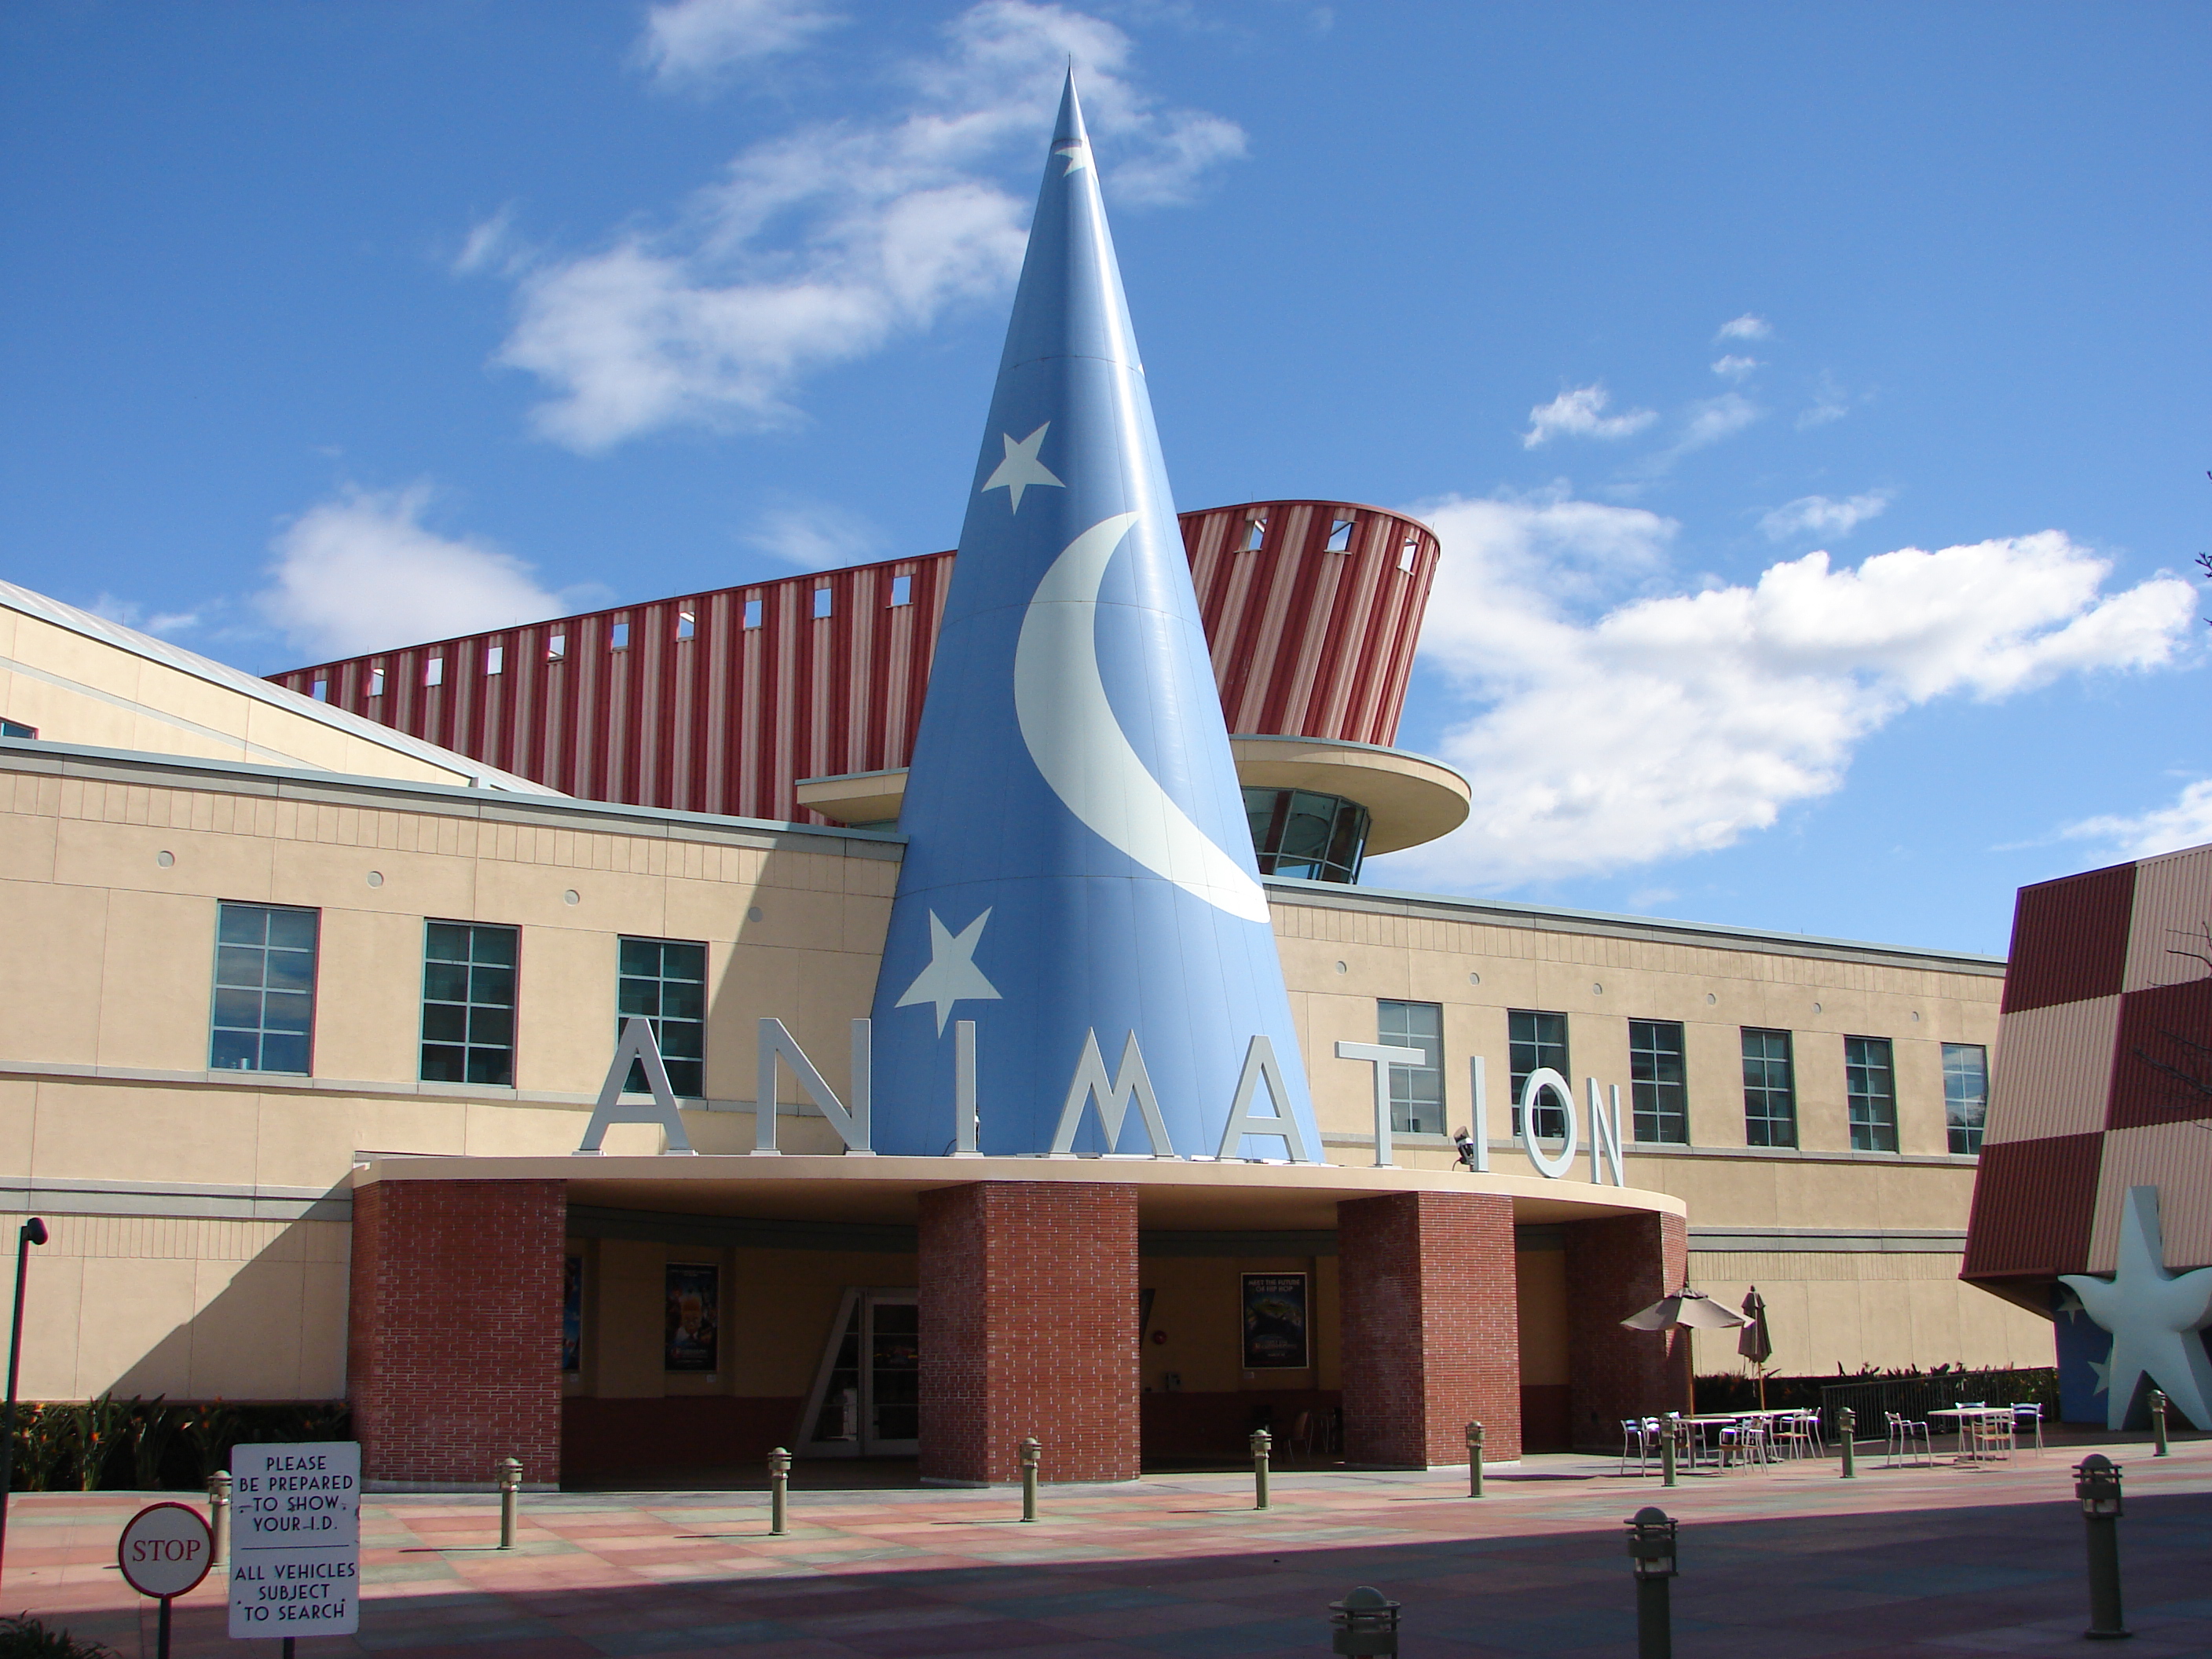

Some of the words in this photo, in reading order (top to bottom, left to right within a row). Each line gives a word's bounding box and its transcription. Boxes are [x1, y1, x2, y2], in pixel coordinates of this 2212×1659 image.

[577, 1016, 1624, 1187] ANIMATION
[266, 1456, 327, 1471] PLEASE
[240, 1477, 259, 1492] BE
[269, 1475, 353, 1492] PREPARED
[253, 1497, 278, 1512] TO
[287, 1495, 339, 1511] SHOW
[254, 1516, 301, 1532] YOUR
[310, 1515, 338, 1531] I.D.
[132, 1539, 201, 1563] STOP
[235, 1566, 265, 1580] ALL
[275, 1562, 355, 1579] VEHICLES
[259, 1584, 330, 1600] SUBJECT
[244, 1606, 269, 1621] TO
[279, 1604, 345, 1621] SEARCH
